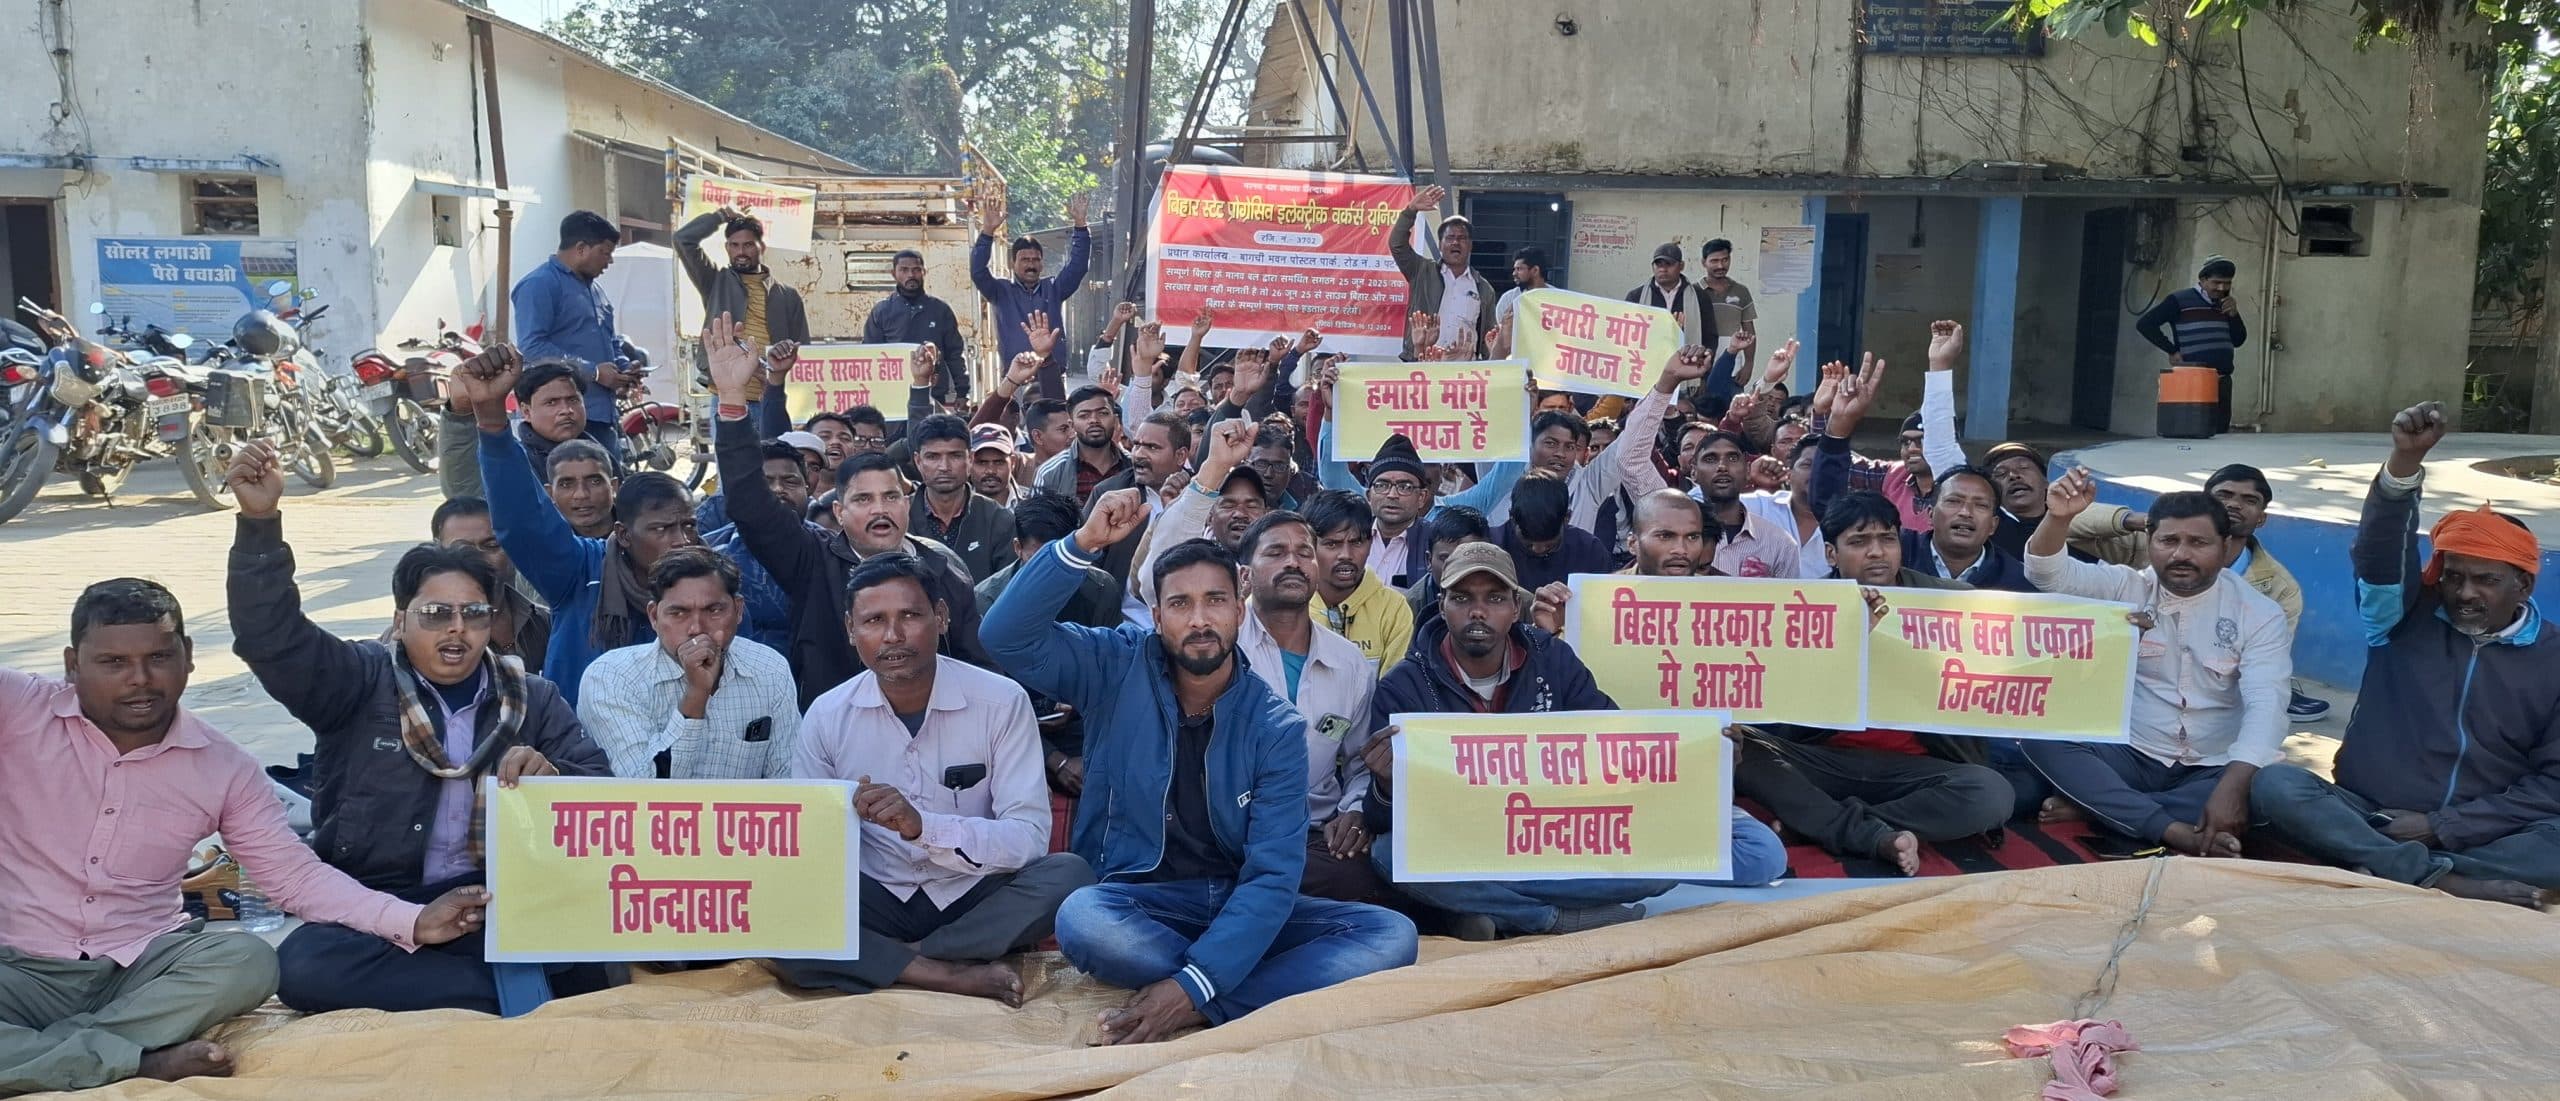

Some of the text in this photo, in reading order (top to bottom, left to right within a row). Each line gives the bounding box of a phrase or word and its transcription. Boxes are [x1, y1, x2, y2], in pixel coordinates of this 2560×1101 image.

[1167, 189, 1403, 235] बिहार स्टेट प्रोग्रेसिव इलेक्ट्रीक वर्कर्स यूनिय
[105, 241, 212, 261] सोलर लगाओ
[1167, 248, 1189, 257] प्रधान
[1268, 255, 1287, 263] भवन
[1290, 254, 1316, 265] पोस्टल
[1344, 257, 1358, 268] रोड
[1384, 260, 1396, 268] पट
[1297, 236, 1316, 244] 3702
[150, 262, 237, 282] पैसे बचाओ
[1164, 282, 1191, 291] सरकार
[1194, 284, 1207, 292] बात
[1226, 285, 1249, 295] मानती
[1251, 286, 1257, 296] है
[1260, 286, 1268, 296] तो
[1271, 289, 1282, 297] 26
[1285, 289, 1297, 301] जून
[1301, 291, 1311, 299] 25
[1314, 289, 1322, 299] से
[1350, 290, 1369, 301] बिहार
[1371, 291, 1386, 302] और
[1166, 267, 1189, 279] सम्पूर्ण
[1192, 267, 1212, 278] बिहार
[1215, 269, 1223, 278] के
[1225, 271, 1244, 279] मानव
[1262, 273, 1278, 282] द्वारा
[1339, 278, 1349, 286] 25
[1351, 277, 1364, 289] जून
[1368, 279, 1388, 287] 2025
[1390, 279, 1405, 288] तक
[1205, 297, 1225, 308] बिहार
[1228, 299, 1237, 308] के
[1238, 300, 1262, 312] सम्पूर्ण
[1540, 303, 1655, 350] हमारी मांगें
[788, 351, 904, 383] बिहार सरकार होश
[1555, 344, 1647, 387] जायज है
[814, 383, 870, 413] मे आओ
[1364, 370, 1492, 411] हमारी मांगें
[1468, 413, 1489, 451] है
[1612, 587, 1838, 650] बिहार सरकार होश
[1897, 607, 2096, 662] मानव बल एकता
[1657, 650, 1767, 710] मे आओ
[1937, 658, 2053, 718] जिन्दाबाद
[1450, 732, 1680, 785] मानव बल एकता
[551, 802, 803, 858] मानव बल एकता
[1504, 792, 1634, 856] जिन्दाबाद
[608, 864, 753, 934] जिन्दाबाद
